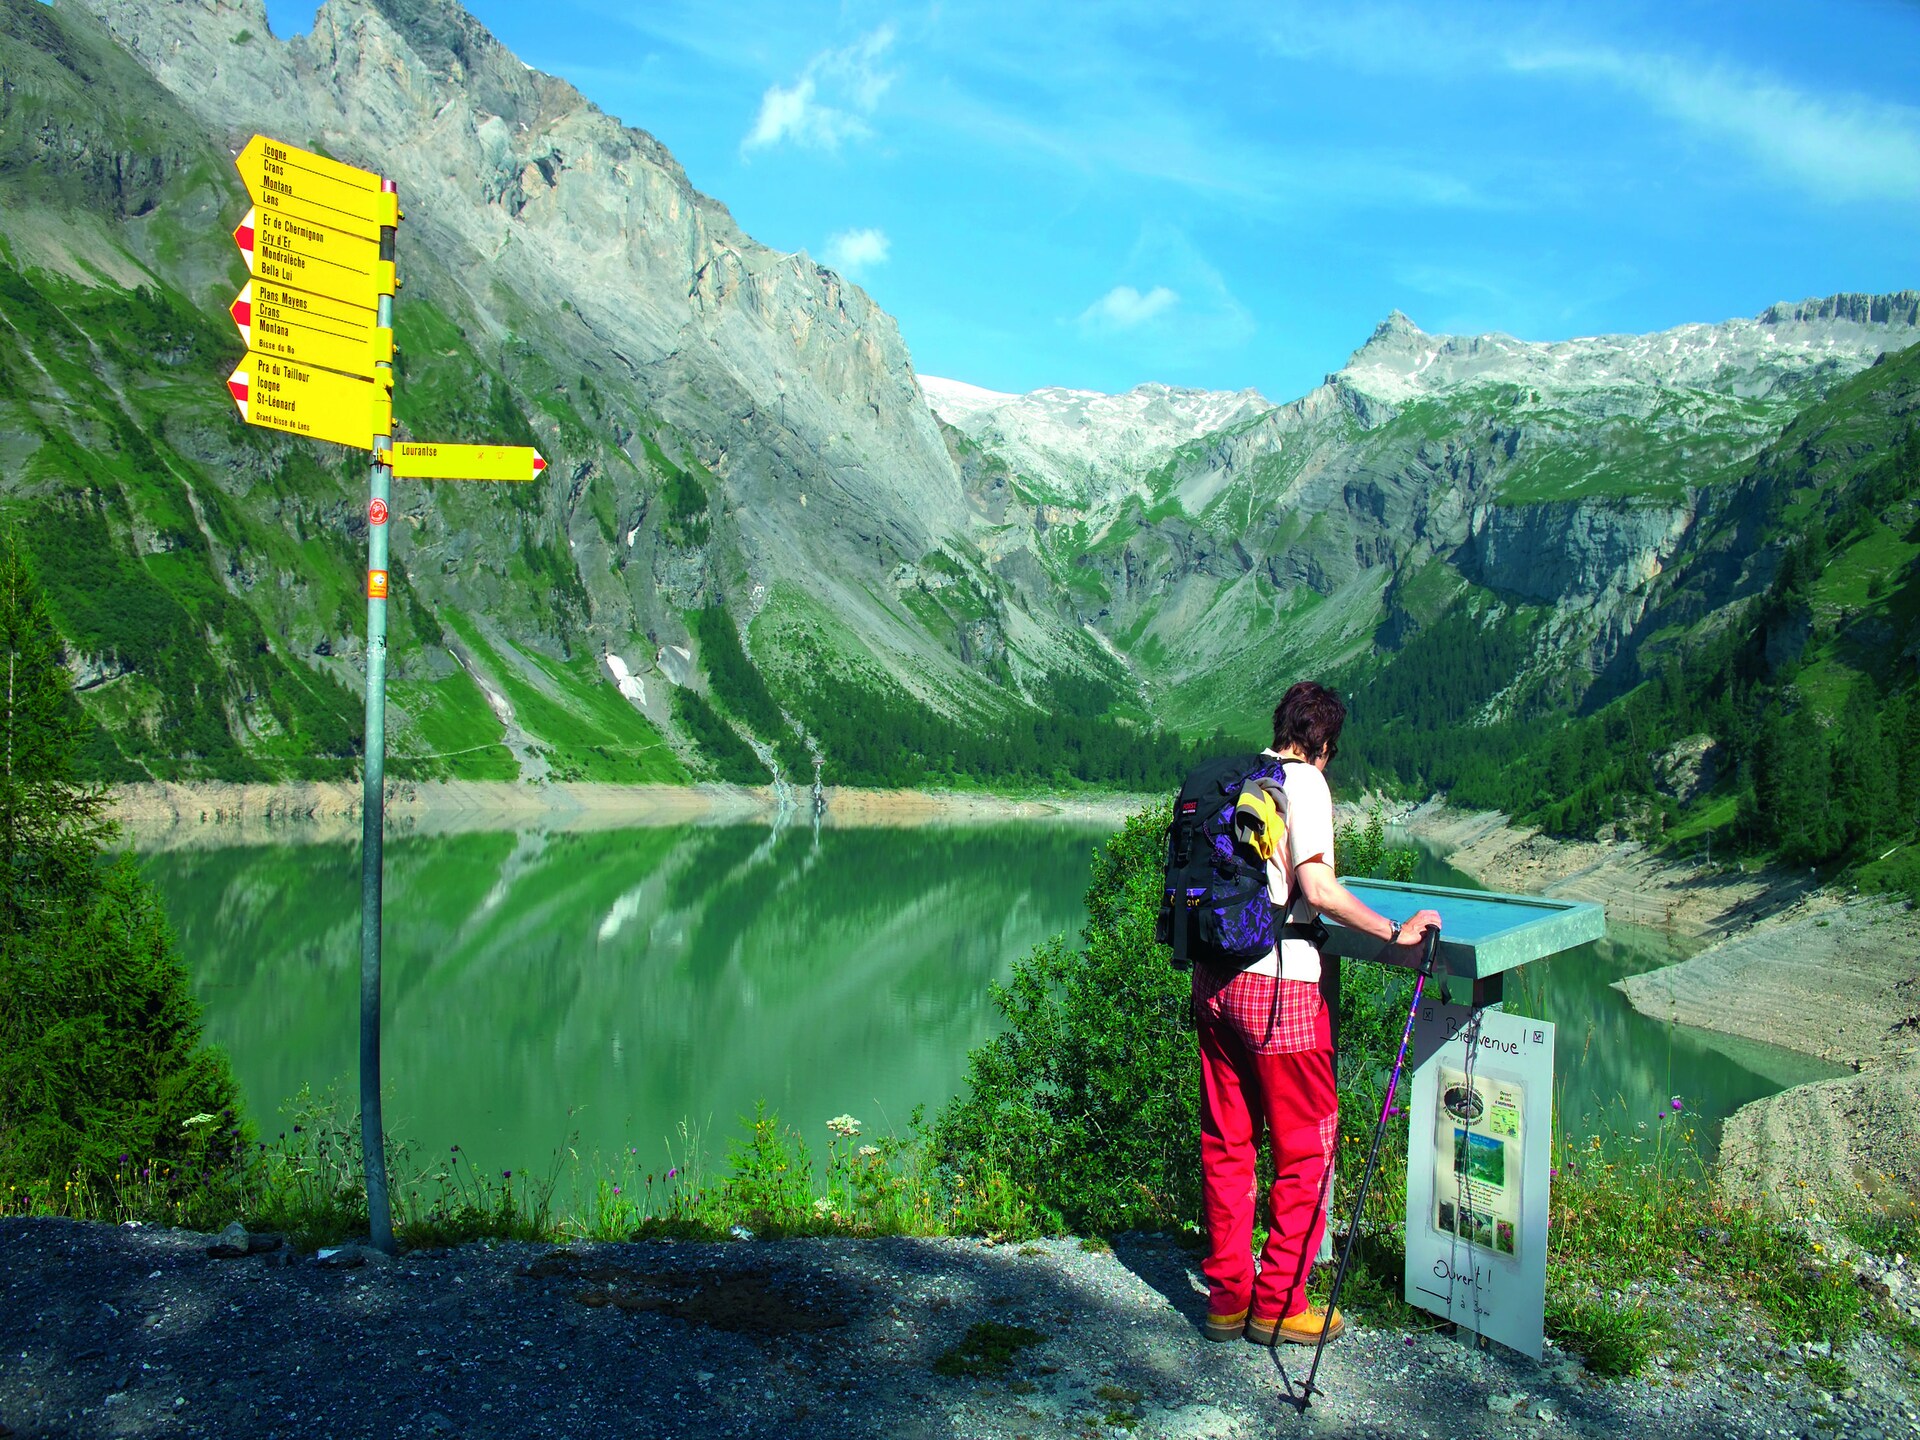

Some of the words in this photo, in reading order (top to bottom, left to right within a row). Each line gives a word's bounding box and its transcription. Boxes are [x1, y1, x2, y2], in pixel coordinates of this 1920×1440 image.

[264, 143, 287, 161] Icogne
[264, 159, 284, 176] Crans
[264, 175, 292, 194] Montana
[263, 191, 279, 206] Lens
[263, 214, 270, 226] Er
[274, 217, 282, 229] de
[284, 220, 324, 243] Chermignon
[262, 230, 274, 245] Cry
[277, 234, 291, 248] d'Er
[262, 262, 279, 277] Bella
[282, 268, 292, 281] Lui
[260, 286, 278, 302] Plans
[282, 292, 307, 309] Mayens
[260, 303, 280, 318] Crans
[259, 319, 289, 337] Montana
[259, 338, 275, 350] Bisse
[278, 344, 284, 352] du
[258, 359, 269, 373] Pra
[272, 362, 281, 375] du
[284, 366, 310, 383] Taillour
[257, 376, 280, 392] Icogne
[257, 392, 296, 412] St-Léonard
[256, 412, 271, 423] Grand
[274, 416, 288, 426] bisse
[290, 420, 295, 428] de
[298, 421, 310, 431] Lens
[402, 444, 437, 456] Lourantse
[1440, 1017, 1519, 1054] Bienvenue
[1433, 1260, 1482, 1290] Ouvert
